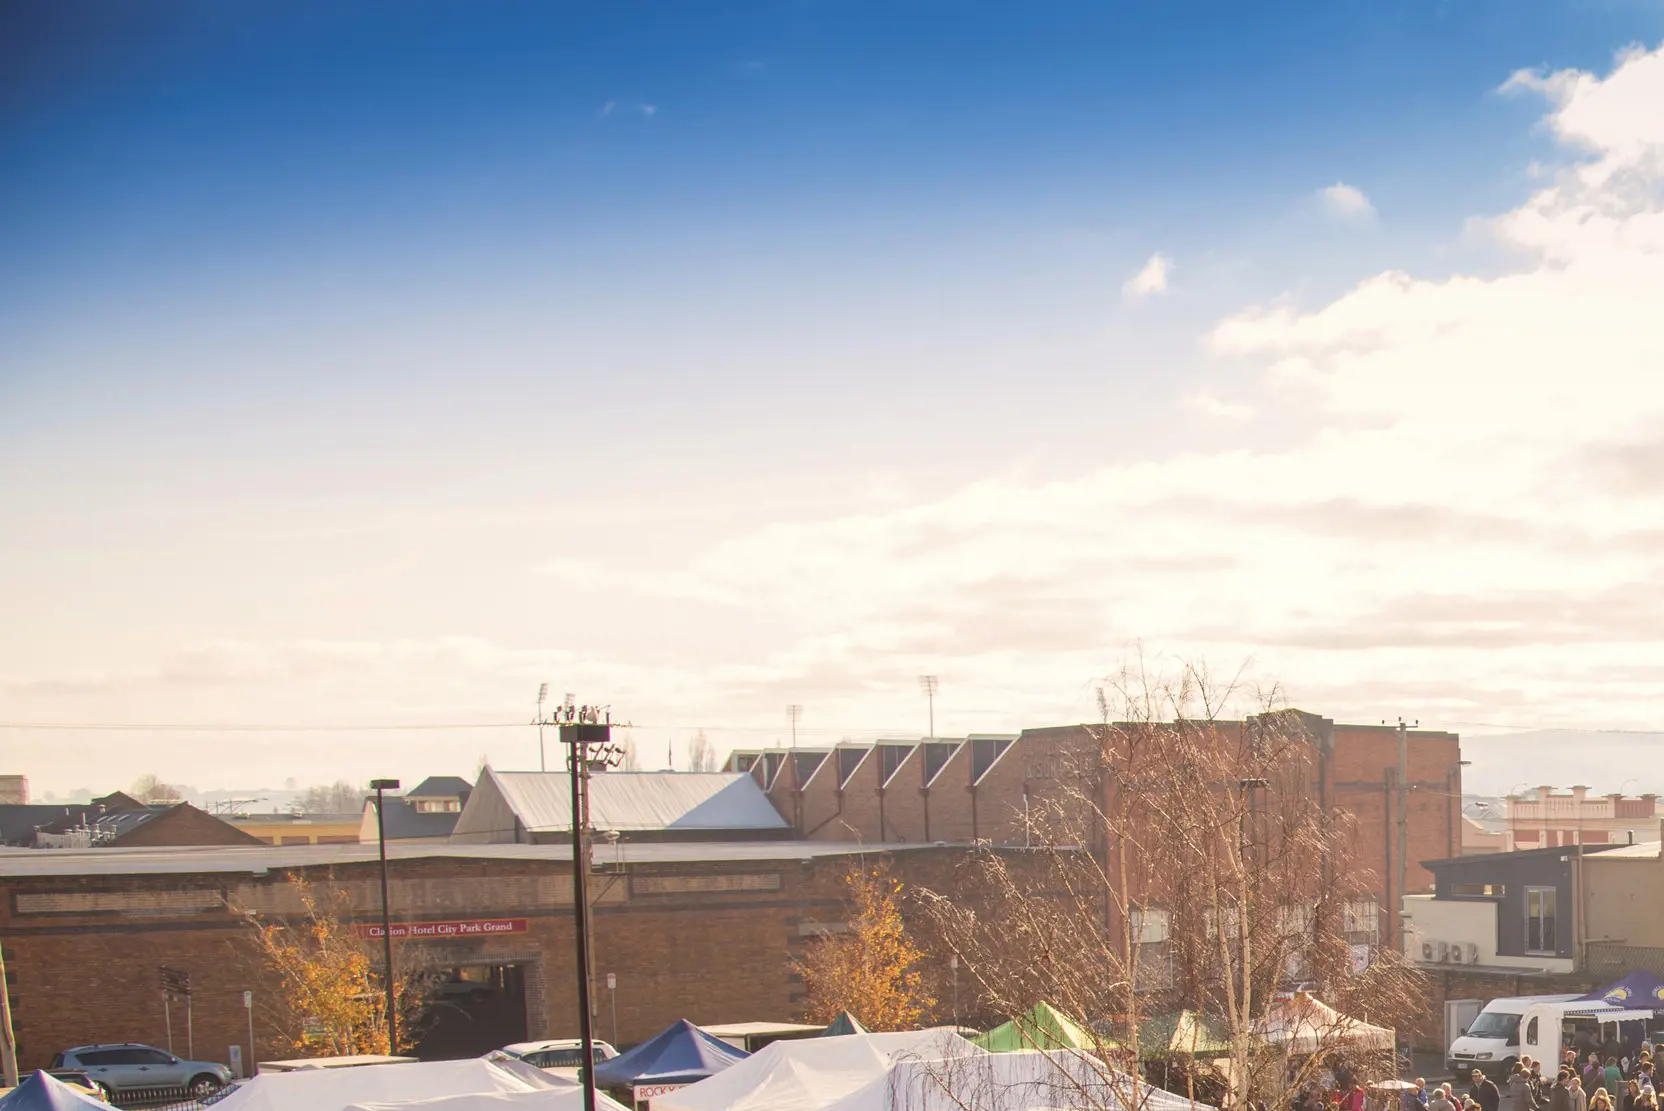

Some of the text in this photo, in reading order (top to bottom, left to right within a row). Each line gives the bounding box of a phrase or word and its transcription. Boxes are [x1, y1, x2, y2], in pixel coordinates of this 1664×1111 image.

[369, 922, 513, 937] Claion Hotel City Park Grand
